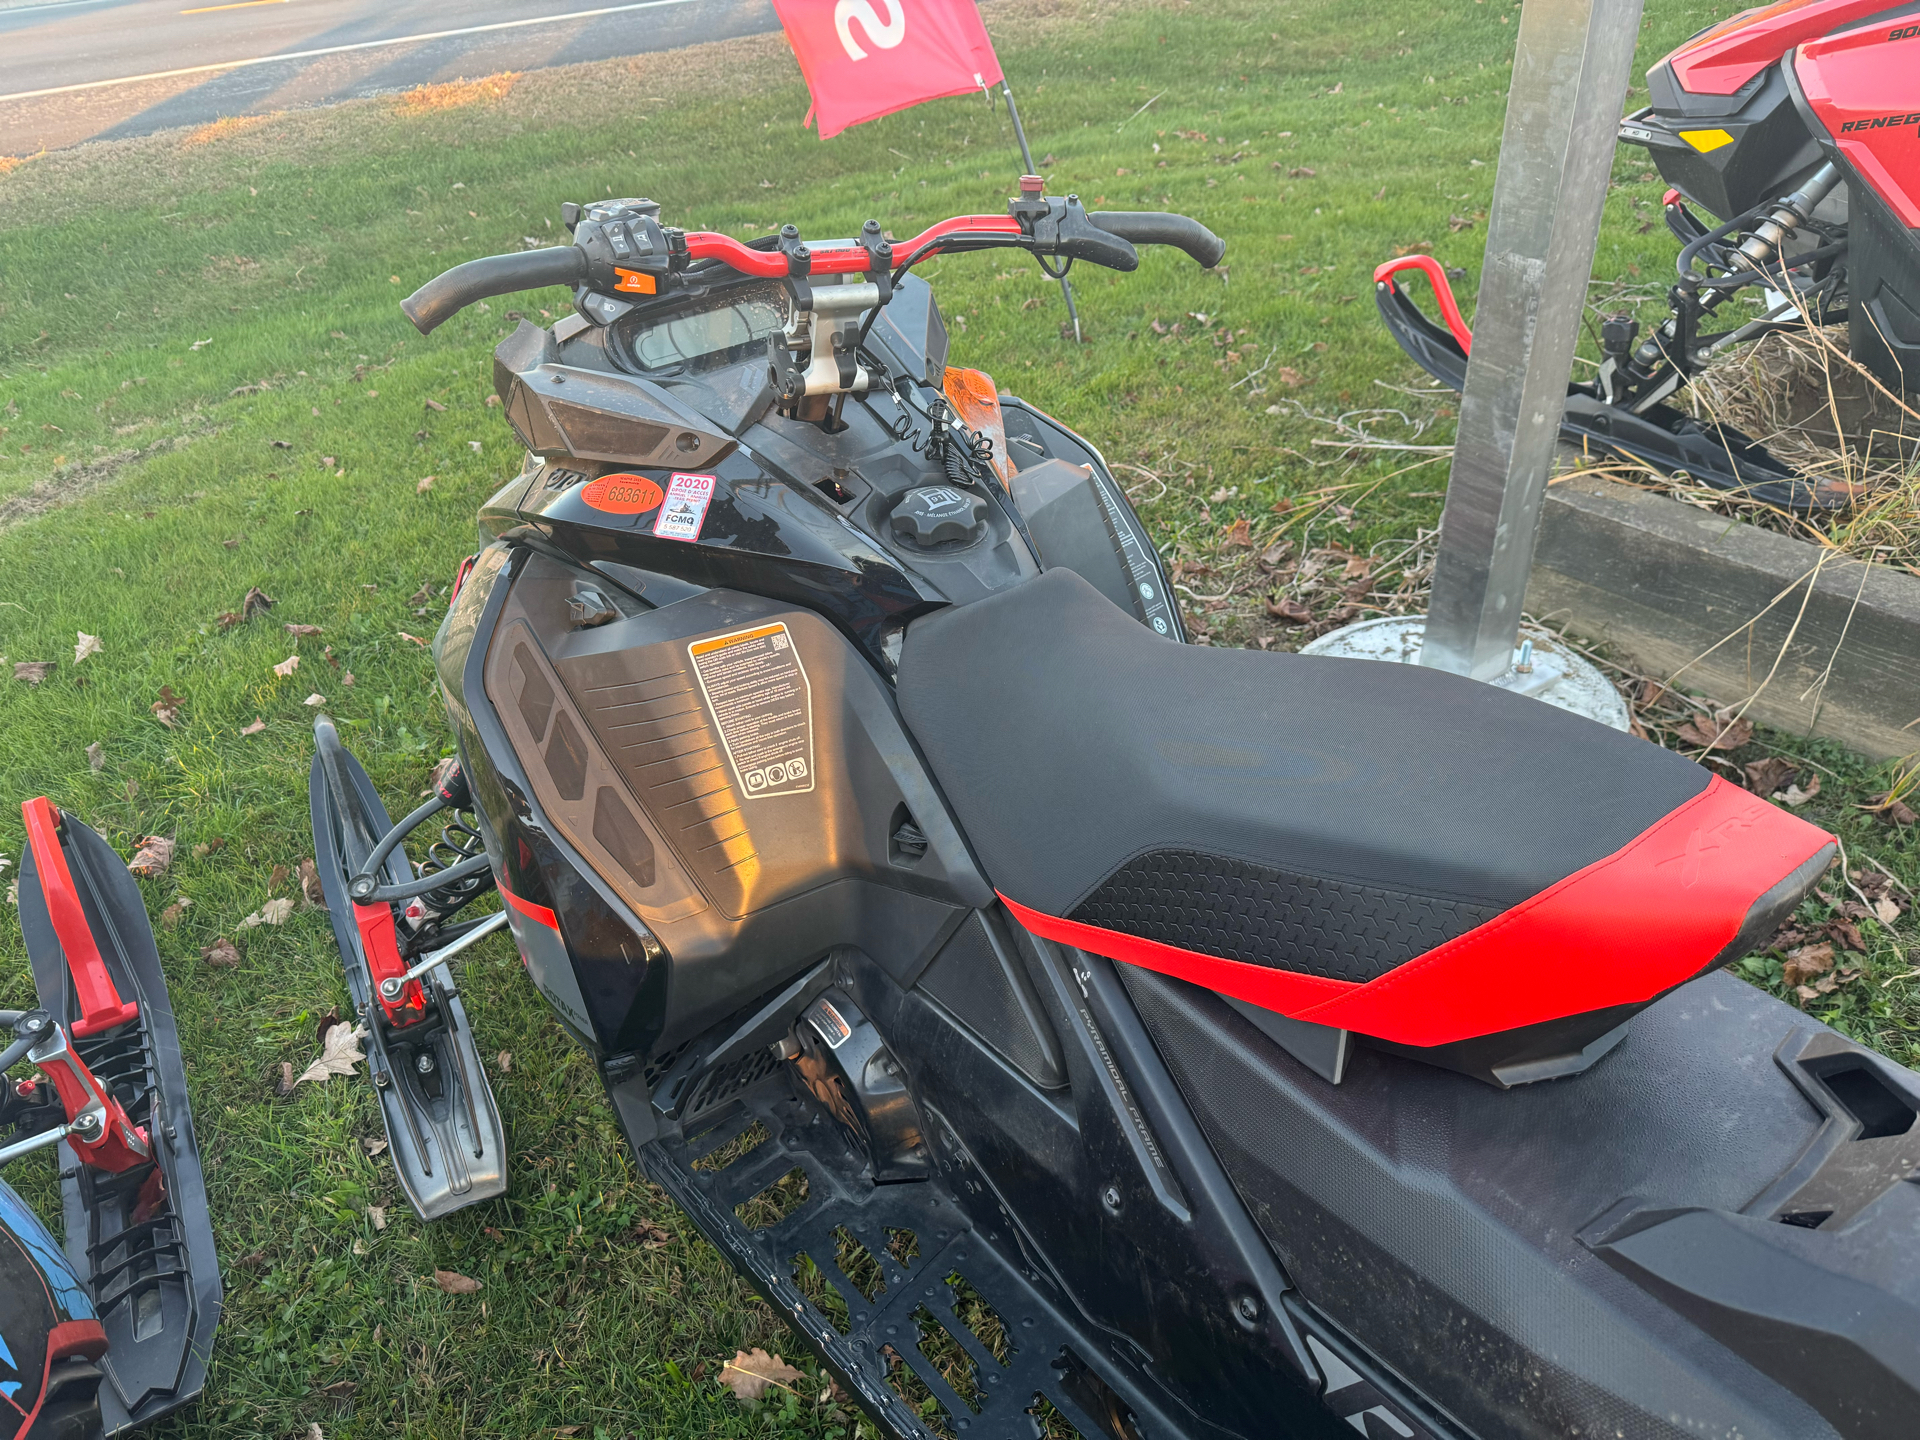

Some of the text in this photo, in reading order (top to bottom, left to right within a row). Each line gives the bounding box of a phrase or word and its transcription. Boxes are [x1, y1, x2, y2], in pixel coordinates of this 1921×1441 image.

[676, 477, 710, 490] 2020
[608, 486, 656, 505] 683611
[666, 514, 694, 526] FCMQ
[728, 634, 754, 644] WARNING
[543, 982, 575, 1020] ROTAX
[1080, 1008, 1165, 1168] PYRAMIDAL FRAME
